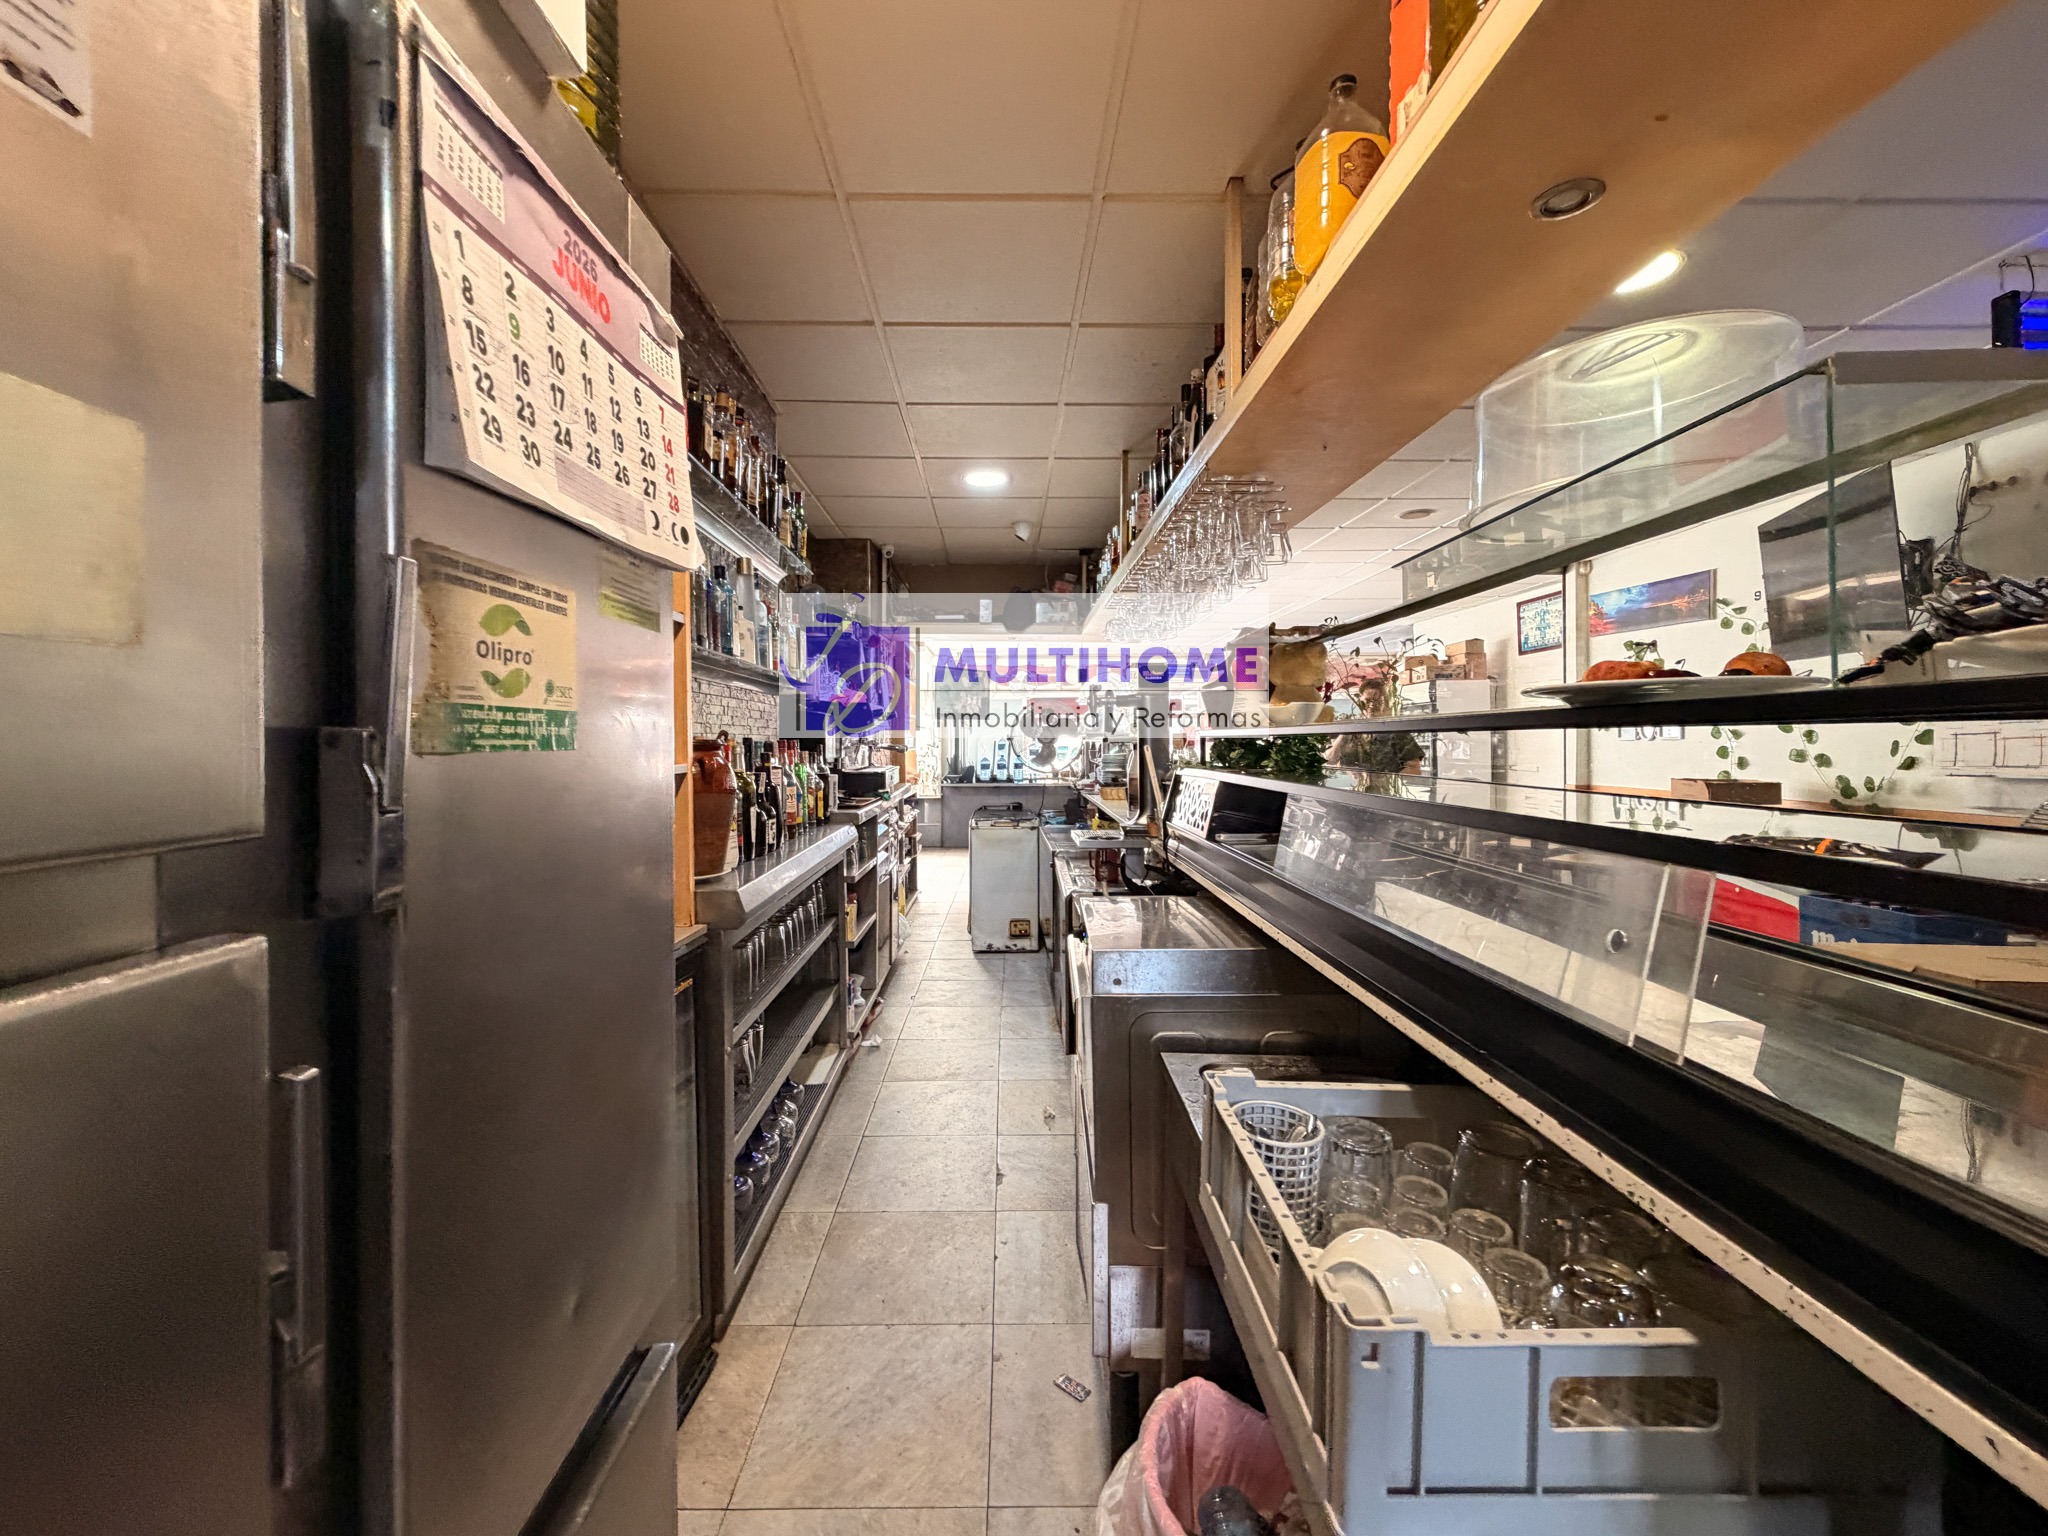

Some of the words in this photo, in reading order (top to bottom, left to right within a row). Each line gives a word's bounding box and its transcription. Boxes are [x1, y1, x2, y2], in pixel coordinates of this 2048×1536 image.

[552, 246, 611, 323] JUNIO
[563, 229, 597, 282] 2026
[454, 230, 465, 260] 1
[505, 271, 517, 302] 2
[546, 307, 554, 332] 3
[580, 338, 588, 360] 4
[608, 363, 614, 385] 5
[635, 387, 641, 407] 6
[659, 405, 664, 424] 7
[462, 274, 474, 306] 8
[508, 312, 520, 340] 9
[547, 345, 565, 376] 10
[582, 373, 593, 399] 11
[610, 397, 622, 423] 12
[637, 417, 650, 439] 13
[662, 435, 673, 457] 14
[464, 318, 487, 356] 15
[513, 354, 530, 387] 16
[550, 383, 565, 411] 17
[584, 407, 597, 434] 18
[612, 429, 624, 453] 19
[640, 447, 656, 470] 20
[665, 464, 675, 485] 21
[473, 364, 496, 403] 22
[516, 394, 536, 428] 23
[553, 420, 573, 451] 24
[587, 442, 601, 469] 25
[614, 461, 630, 486] 26
[643, 477, 657, 500] 27
[668, 492, 680, 513] 28
[481, 408, 503, 443] 29
[520, 435, 541, 467] 30
[476, 640, 533, 666] Olipro
